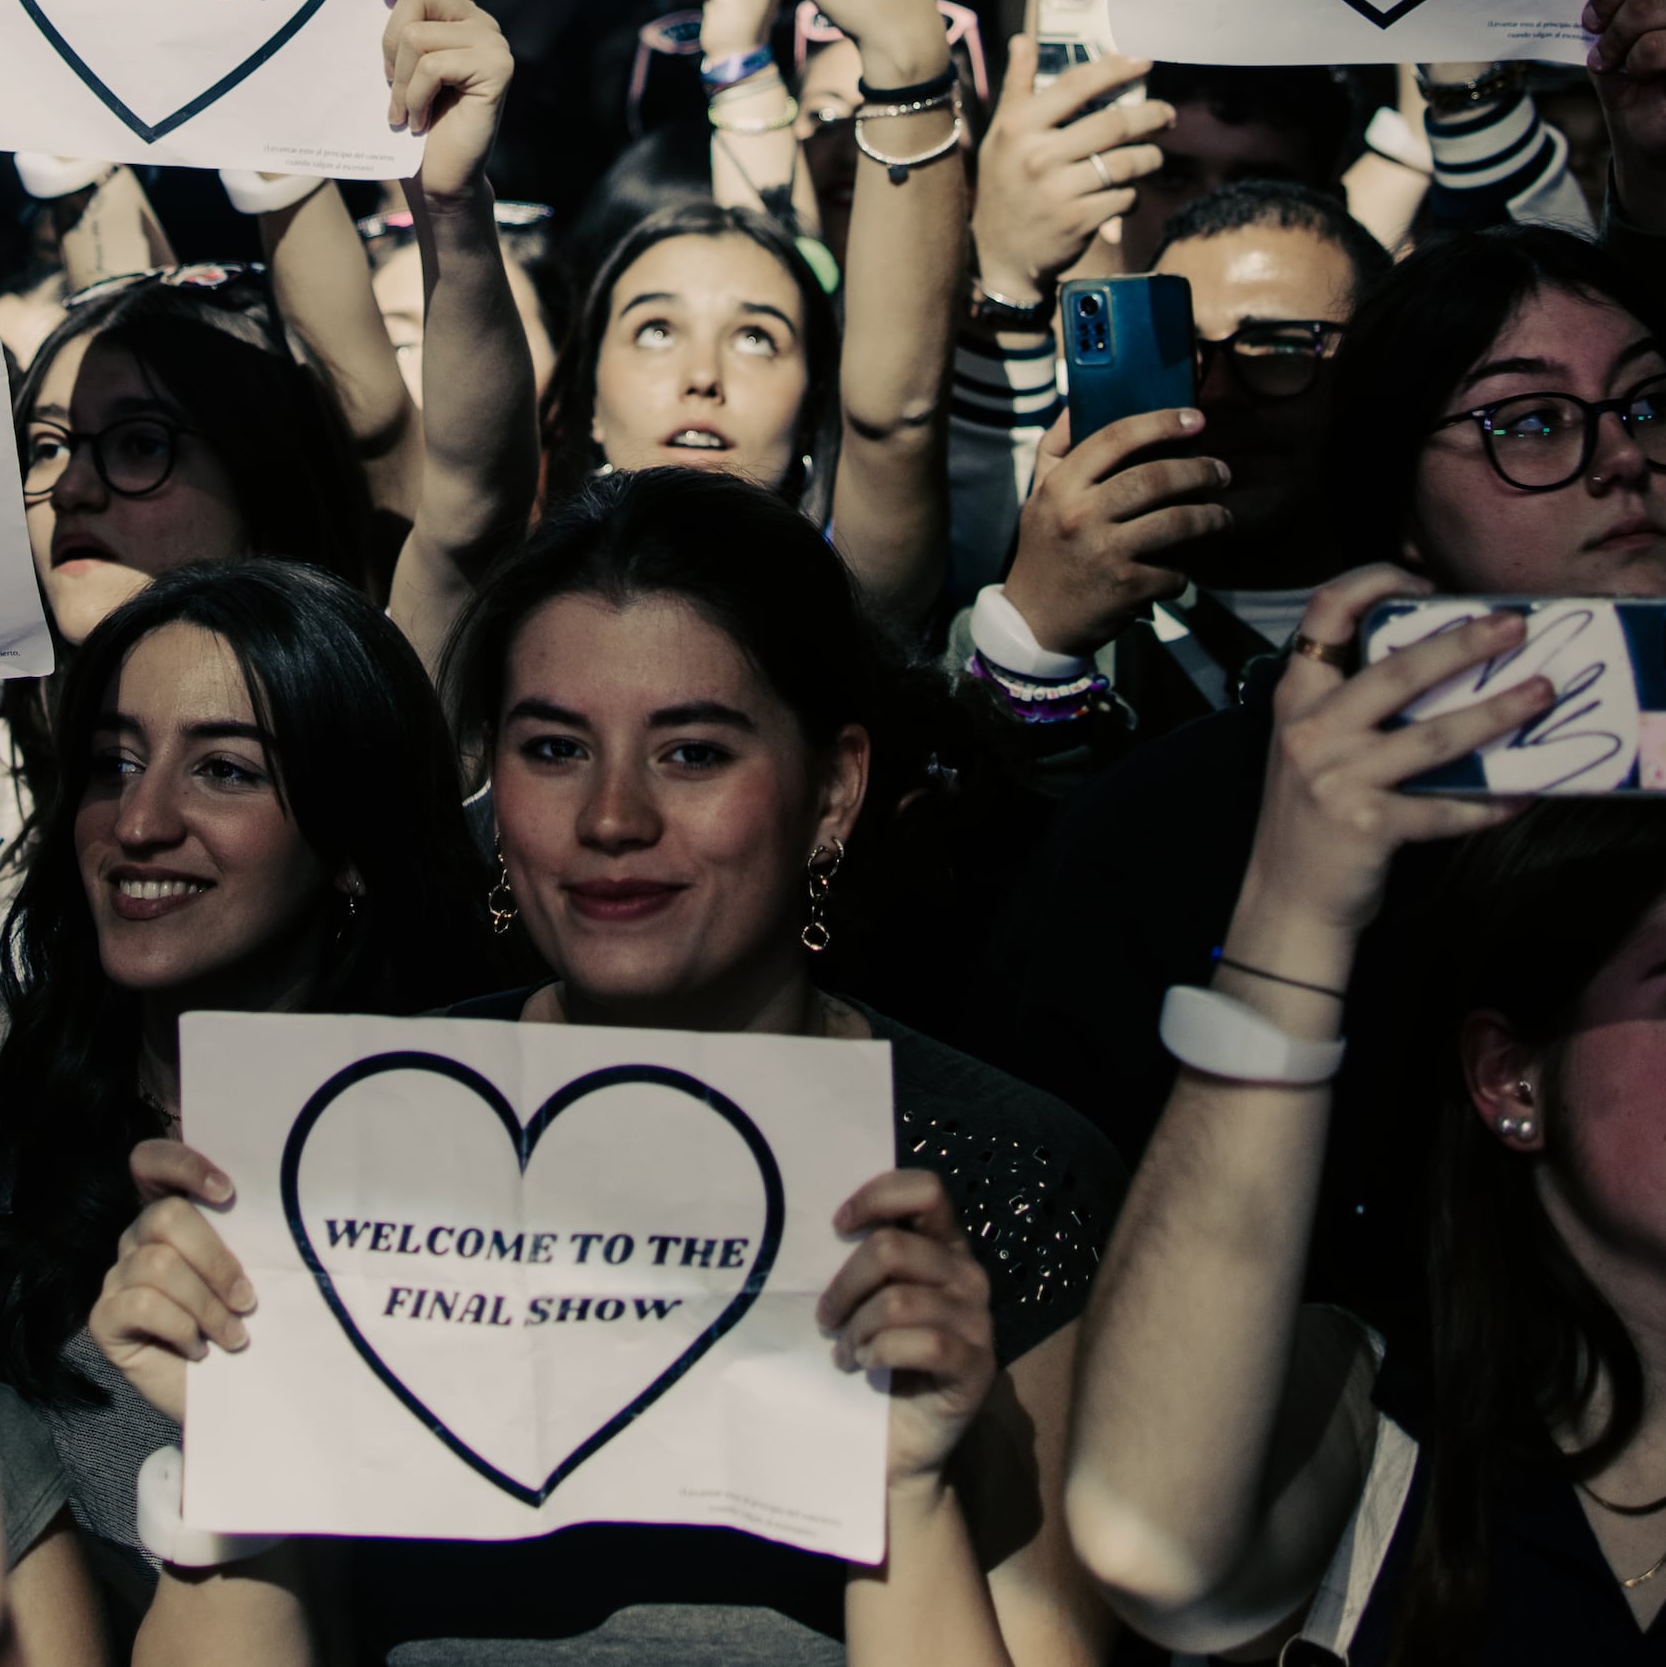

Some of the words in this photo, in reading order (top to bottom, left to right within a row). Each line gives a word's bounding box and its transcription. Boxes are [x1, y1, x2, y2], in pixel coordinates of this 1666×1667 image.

[324, 1218, 557, 1264] WELCOME
[570, 1232, 634, 1266] TO
[647, 1234, 750, 1269] THE
[382, 1285, 512, 1326] FINAL
[522, 1296, 683, 1327] SHOW
